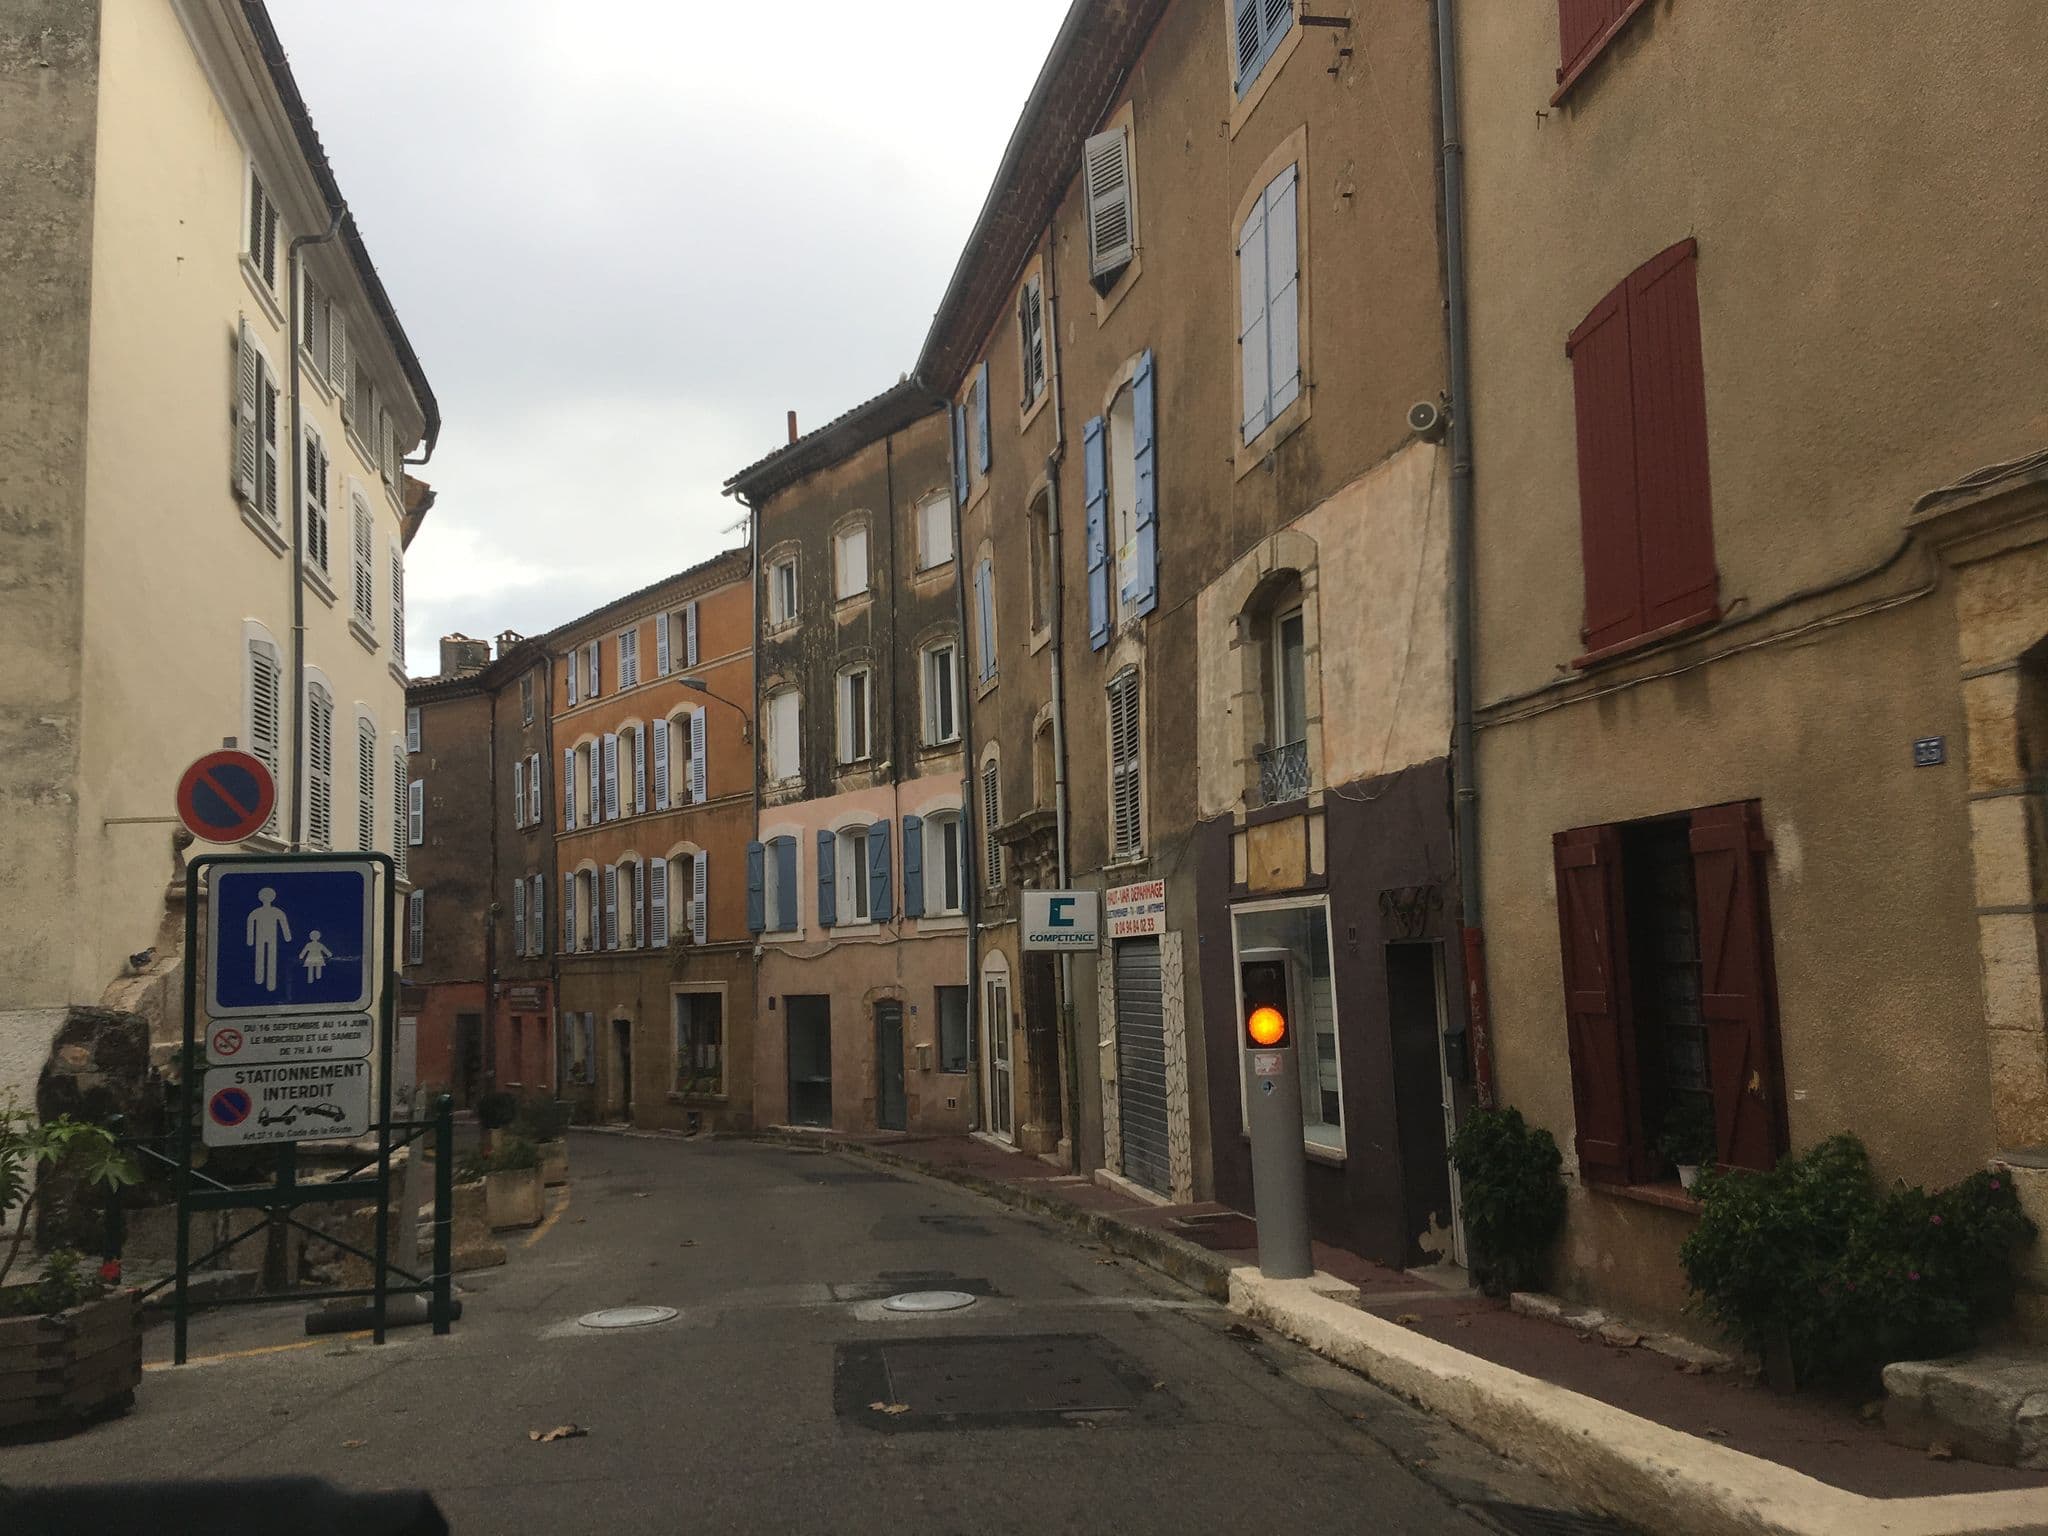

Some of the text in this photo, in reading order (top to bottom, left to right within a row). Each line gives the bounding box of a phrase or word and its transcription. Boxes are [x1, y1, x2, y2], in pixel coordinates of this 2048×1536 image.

[1029, 934, 1095, 943] COMPETENCE
[244, 1018, 369, 1032] DU 16 SEPTEMBRE AU 14 JUIN
[250, 1032, 361, 1044] LE MERCREDI ET LE SAMEDI
[279, 1047, 291, 1056] DE
[294, 1046, 305, 1054] 7H
[316, 1045, 333, 1053] 14H
[235, 1063, 364, 1084] STATIONNEMENT
[263, 1083, 334, 1101] INTERDIT
[286, 1128, 307, 1138] Code
[308, 1127, 319, 1136] de
[329, 1125, 352, 1135] Route
